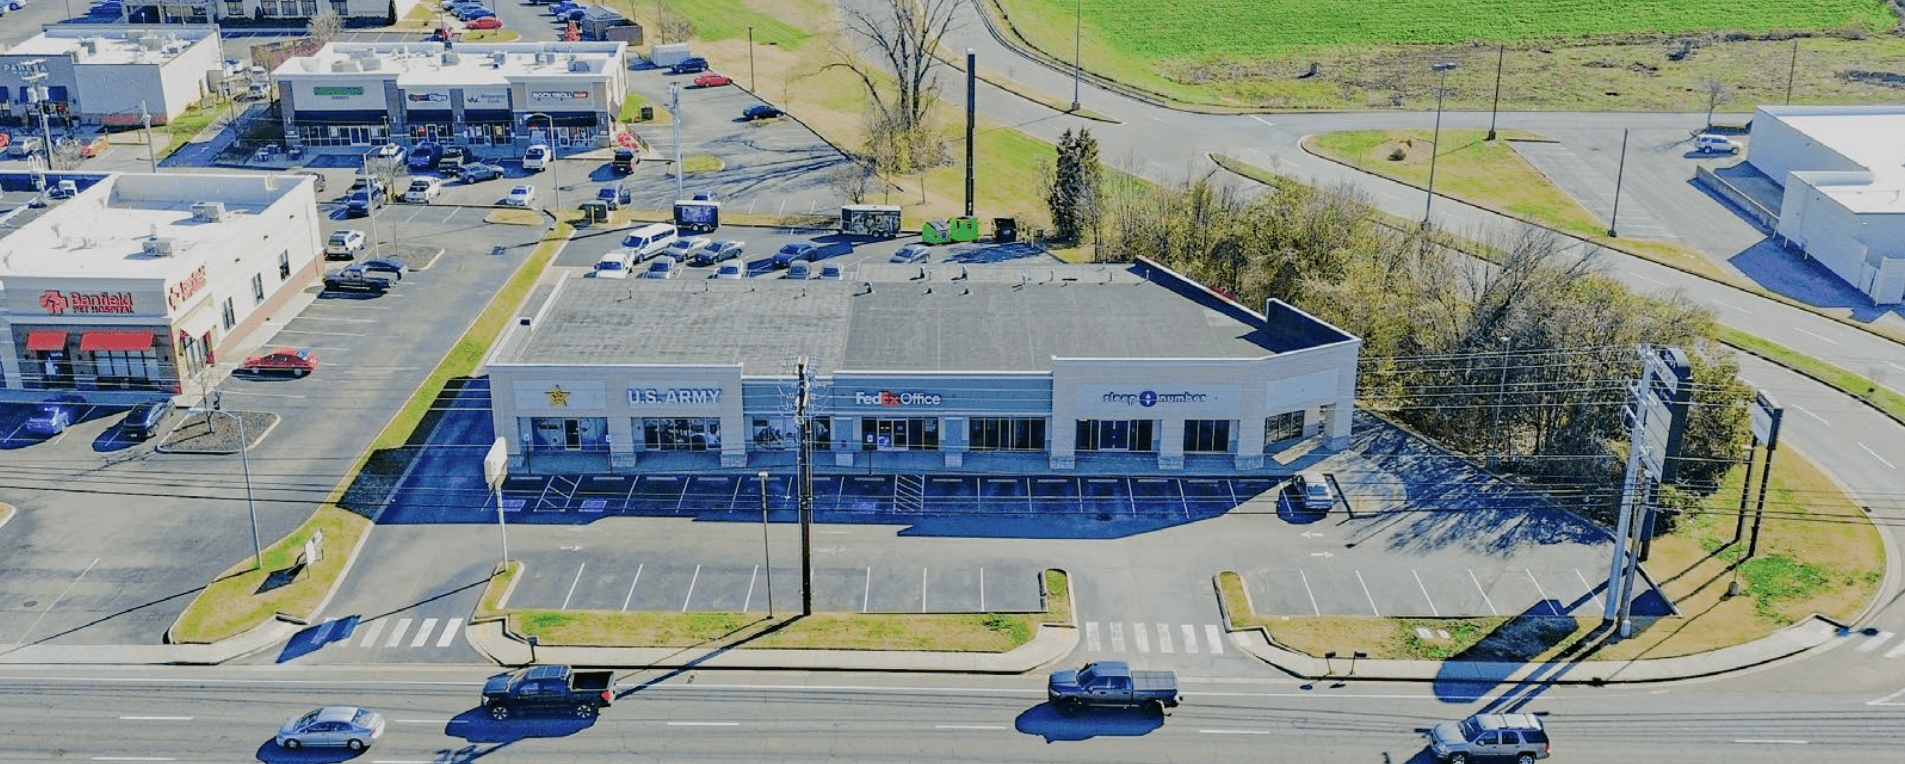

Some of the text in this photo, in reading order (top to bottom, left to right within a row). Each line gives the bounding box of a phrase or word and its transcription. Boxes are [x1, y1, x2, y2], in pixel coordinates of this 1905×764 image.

[69, 291, 133, 306] Banfield
[627, 388, 721, 404] U.S. ARMY
[1102, 391, 1206, 405] sleep number
